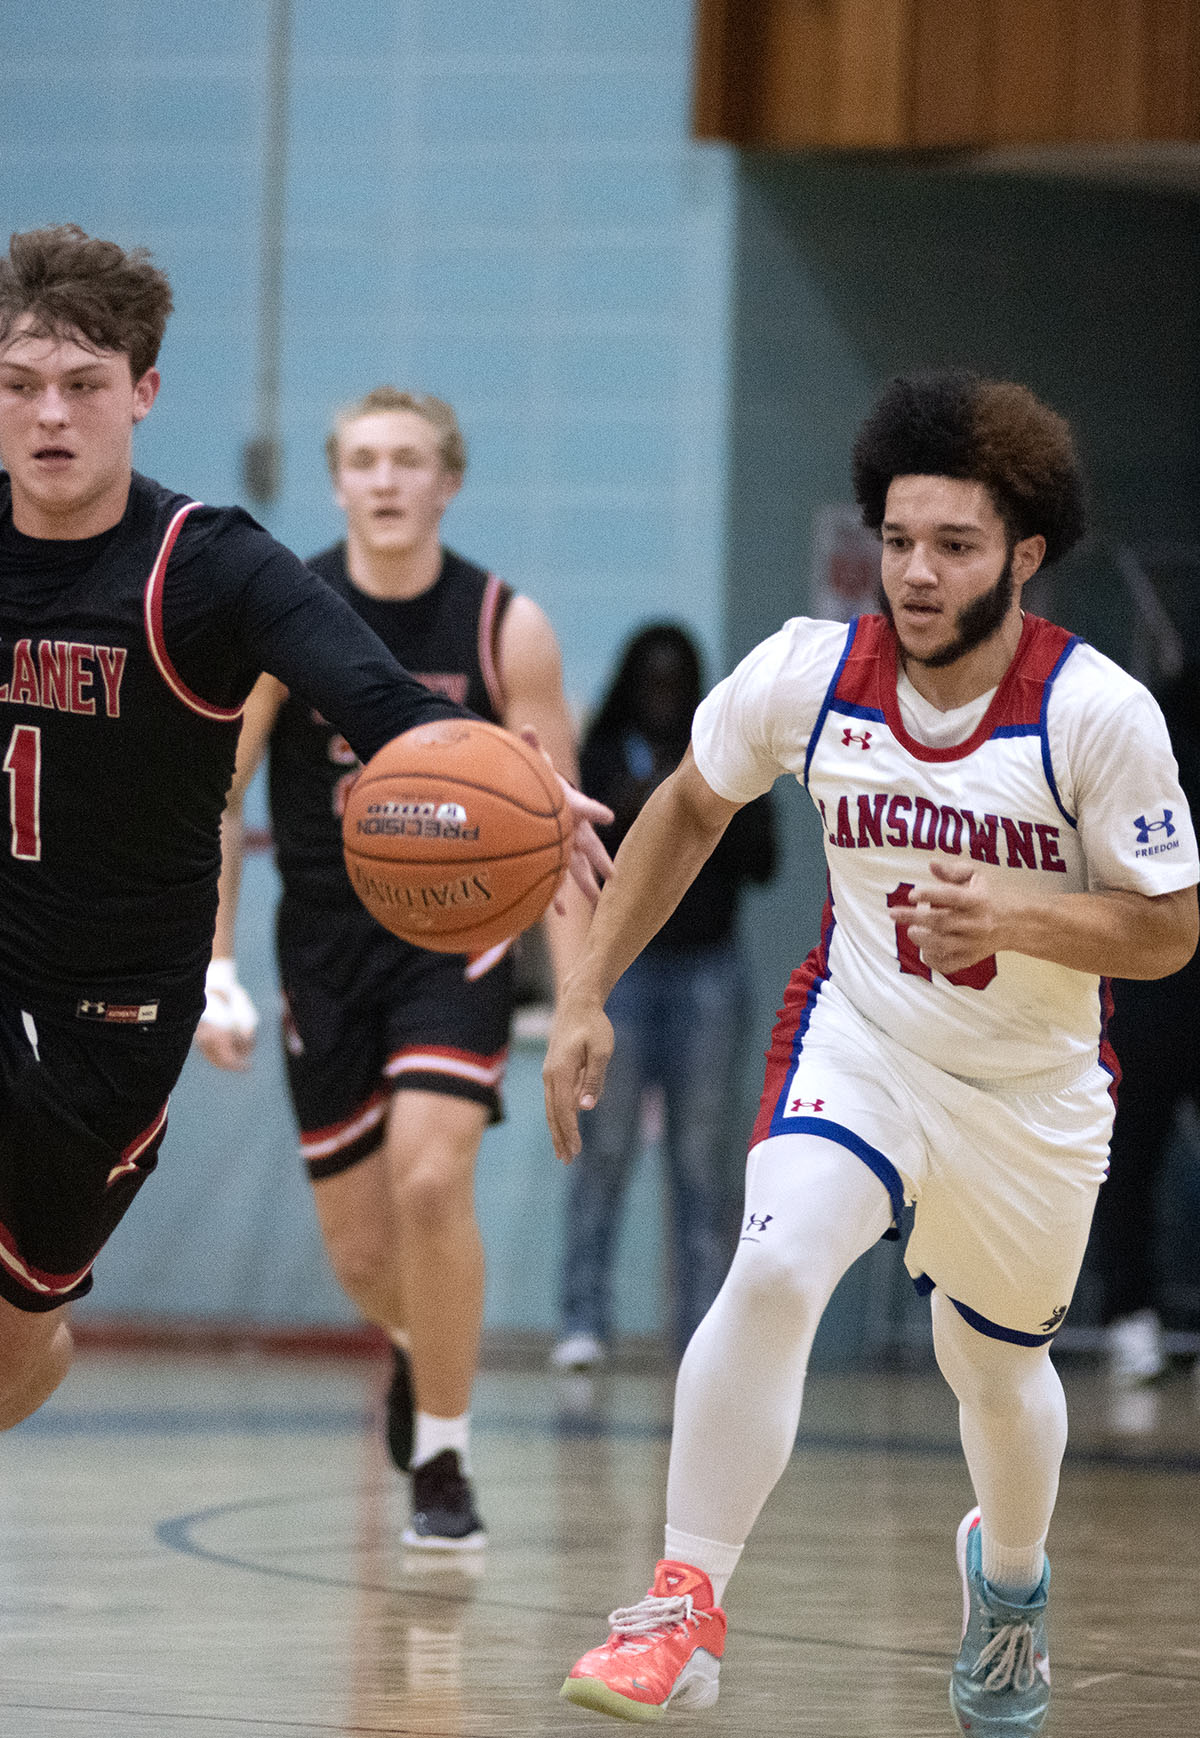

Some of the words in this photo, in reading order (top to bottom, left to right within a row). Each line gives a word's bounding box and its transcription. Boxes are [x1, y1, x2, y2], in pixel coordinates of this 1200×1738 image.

[3, 724, 41, 861] 1
[356, 818, 480, 841] PRECISION
[1135, 840, 1180, 858] FREEDOM
[886, 882, 998, 990] 1
